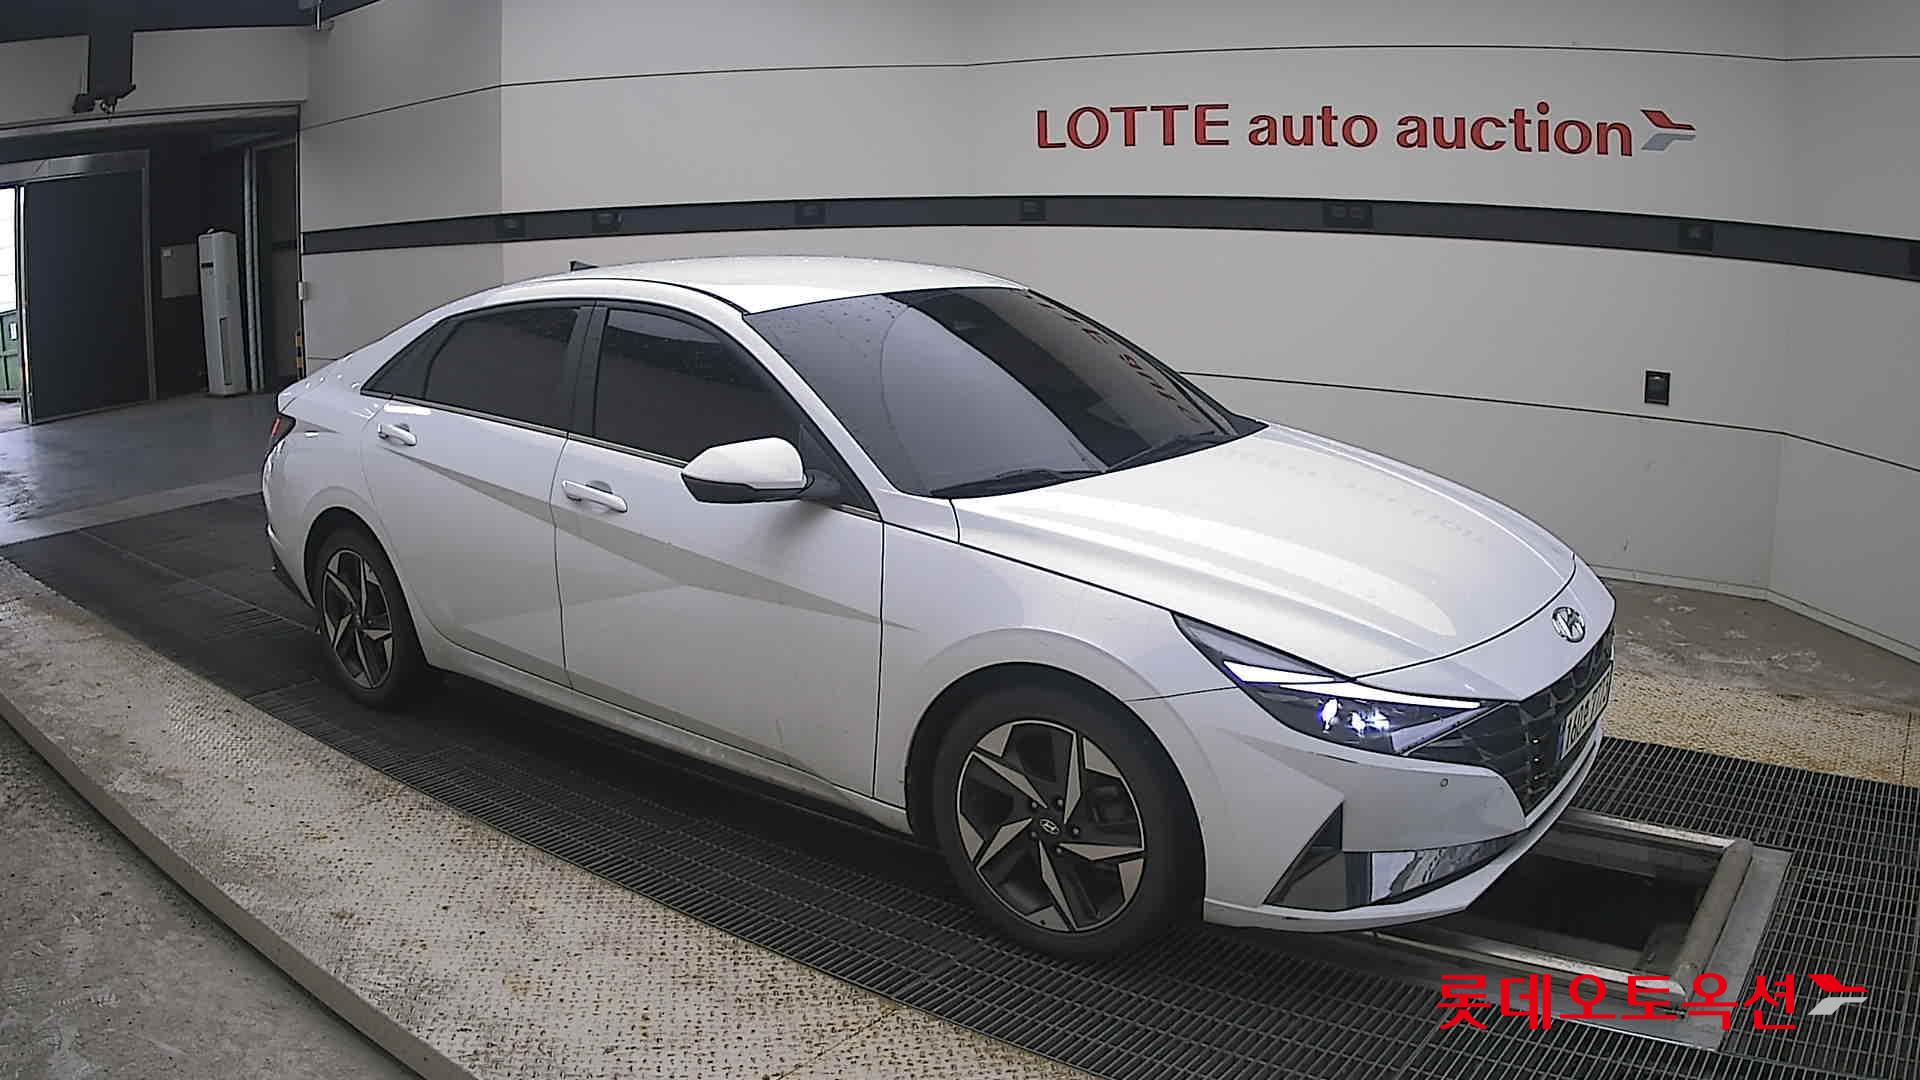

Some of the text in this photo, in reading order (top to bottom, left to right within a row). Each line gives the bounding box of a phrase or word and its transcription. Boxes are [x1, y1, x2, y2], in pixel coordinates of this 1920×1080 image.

[1036, 101, 1633, 157] LOTTE auto auction
